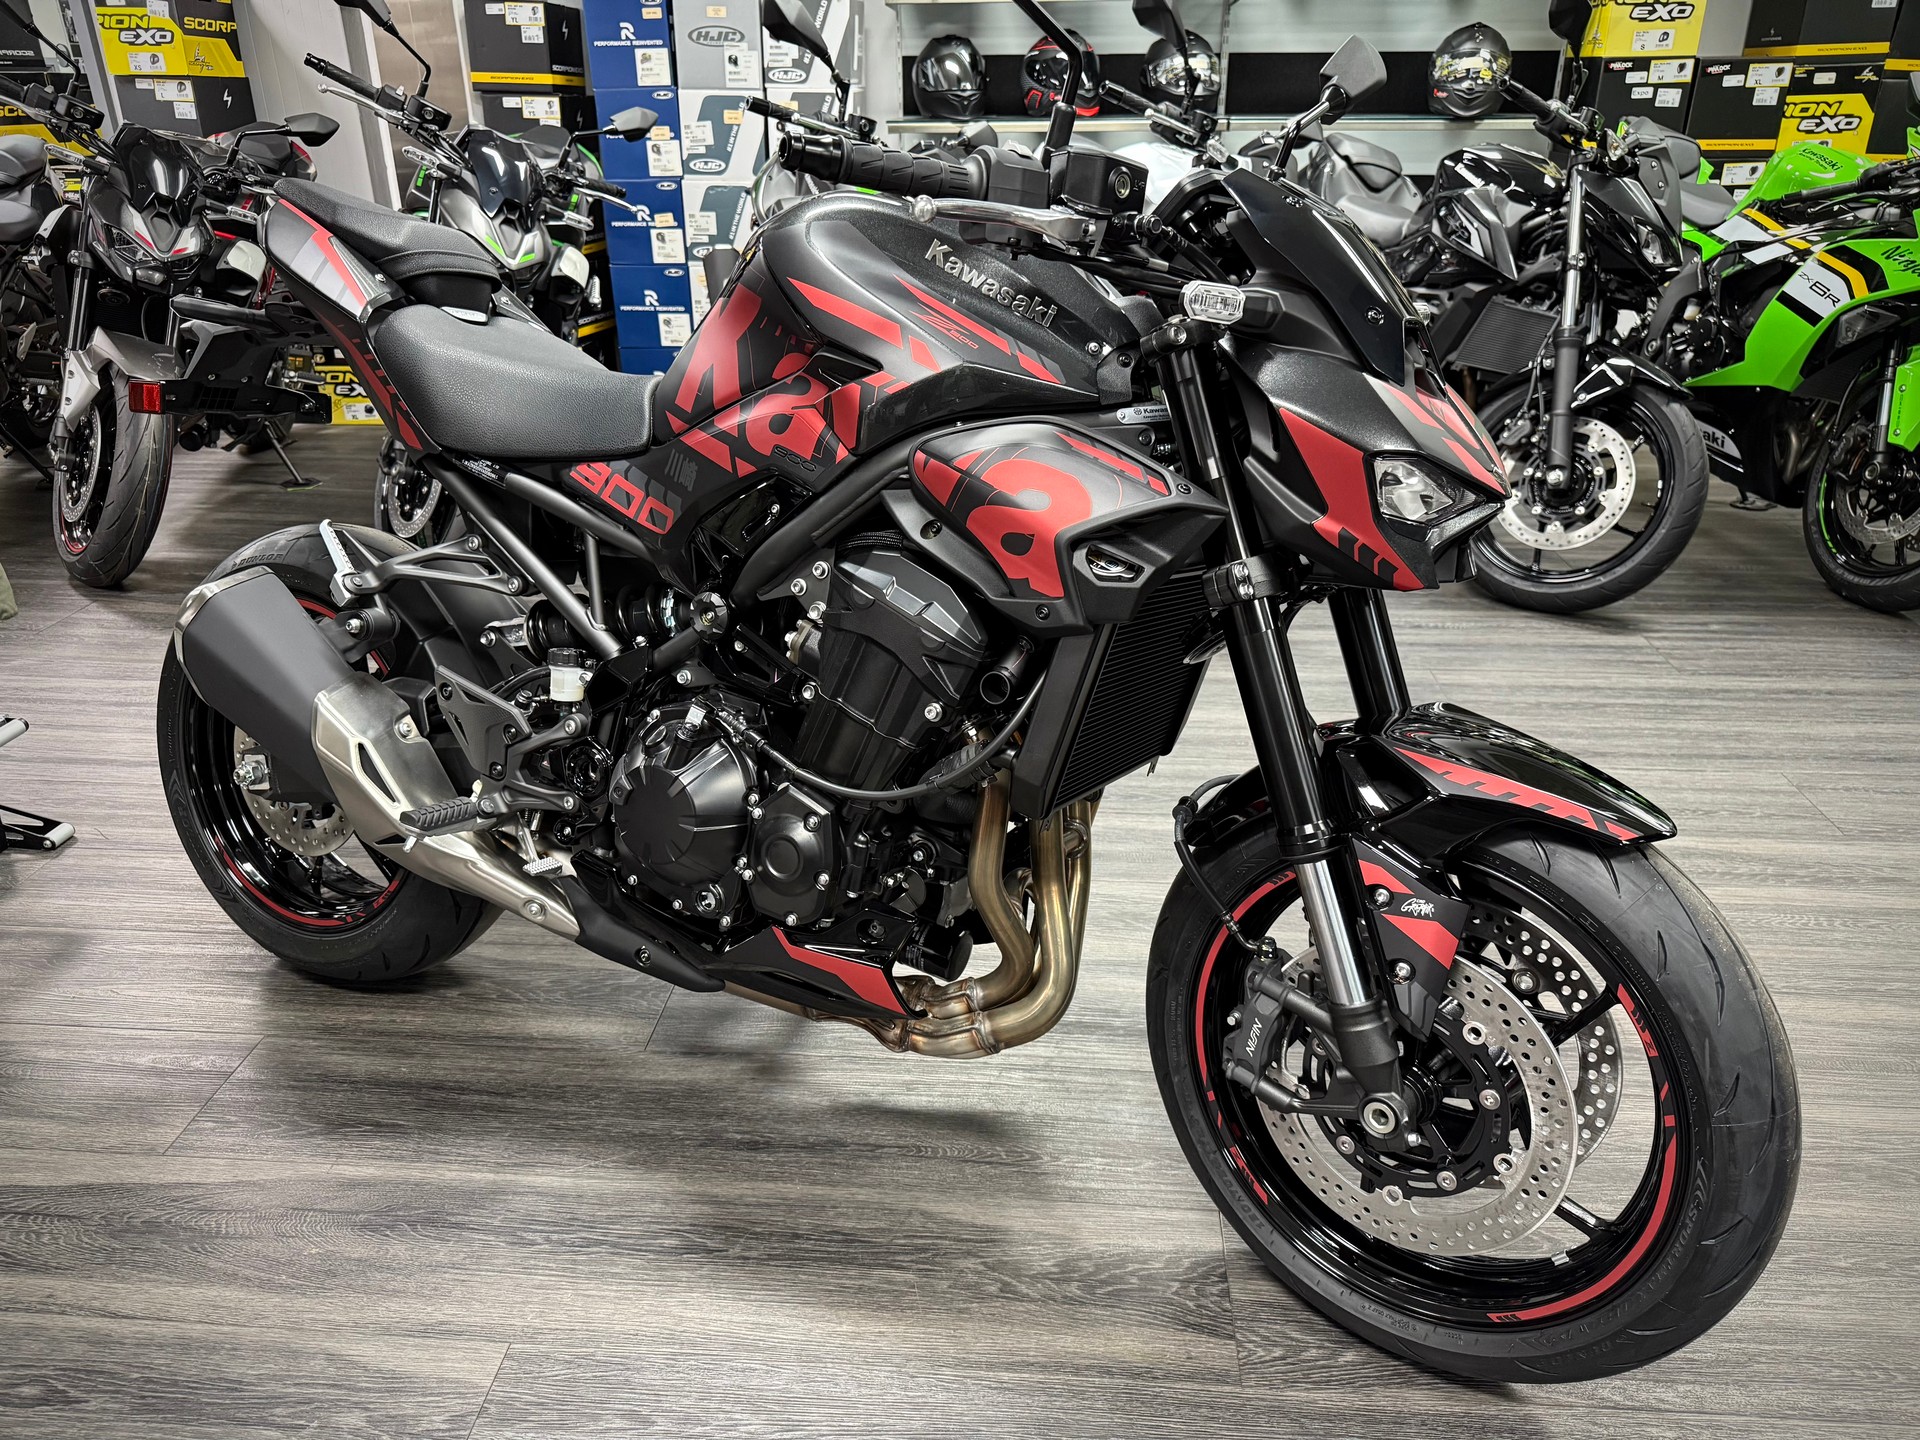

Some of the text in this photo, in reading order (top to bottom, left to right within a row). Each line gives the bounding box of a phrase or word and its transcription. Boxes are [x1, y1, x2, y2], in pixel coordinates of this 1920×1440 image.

[1630, 3, 1695, 21] EXO
[183, 16, 238, 33] SCORP
[119, 29, 173, 45] EXO
[695, 31, 738, 42] HJC
[772, 71, 801, 80] HJC
[1784, 102, 1842, 118] ION
[1797, 115, 1861, 133] EXO
[694, 160, 721, 170] HJC
[924, 238, 1059, 328] Kawasaki
[569, 461, 675, 535] 900
